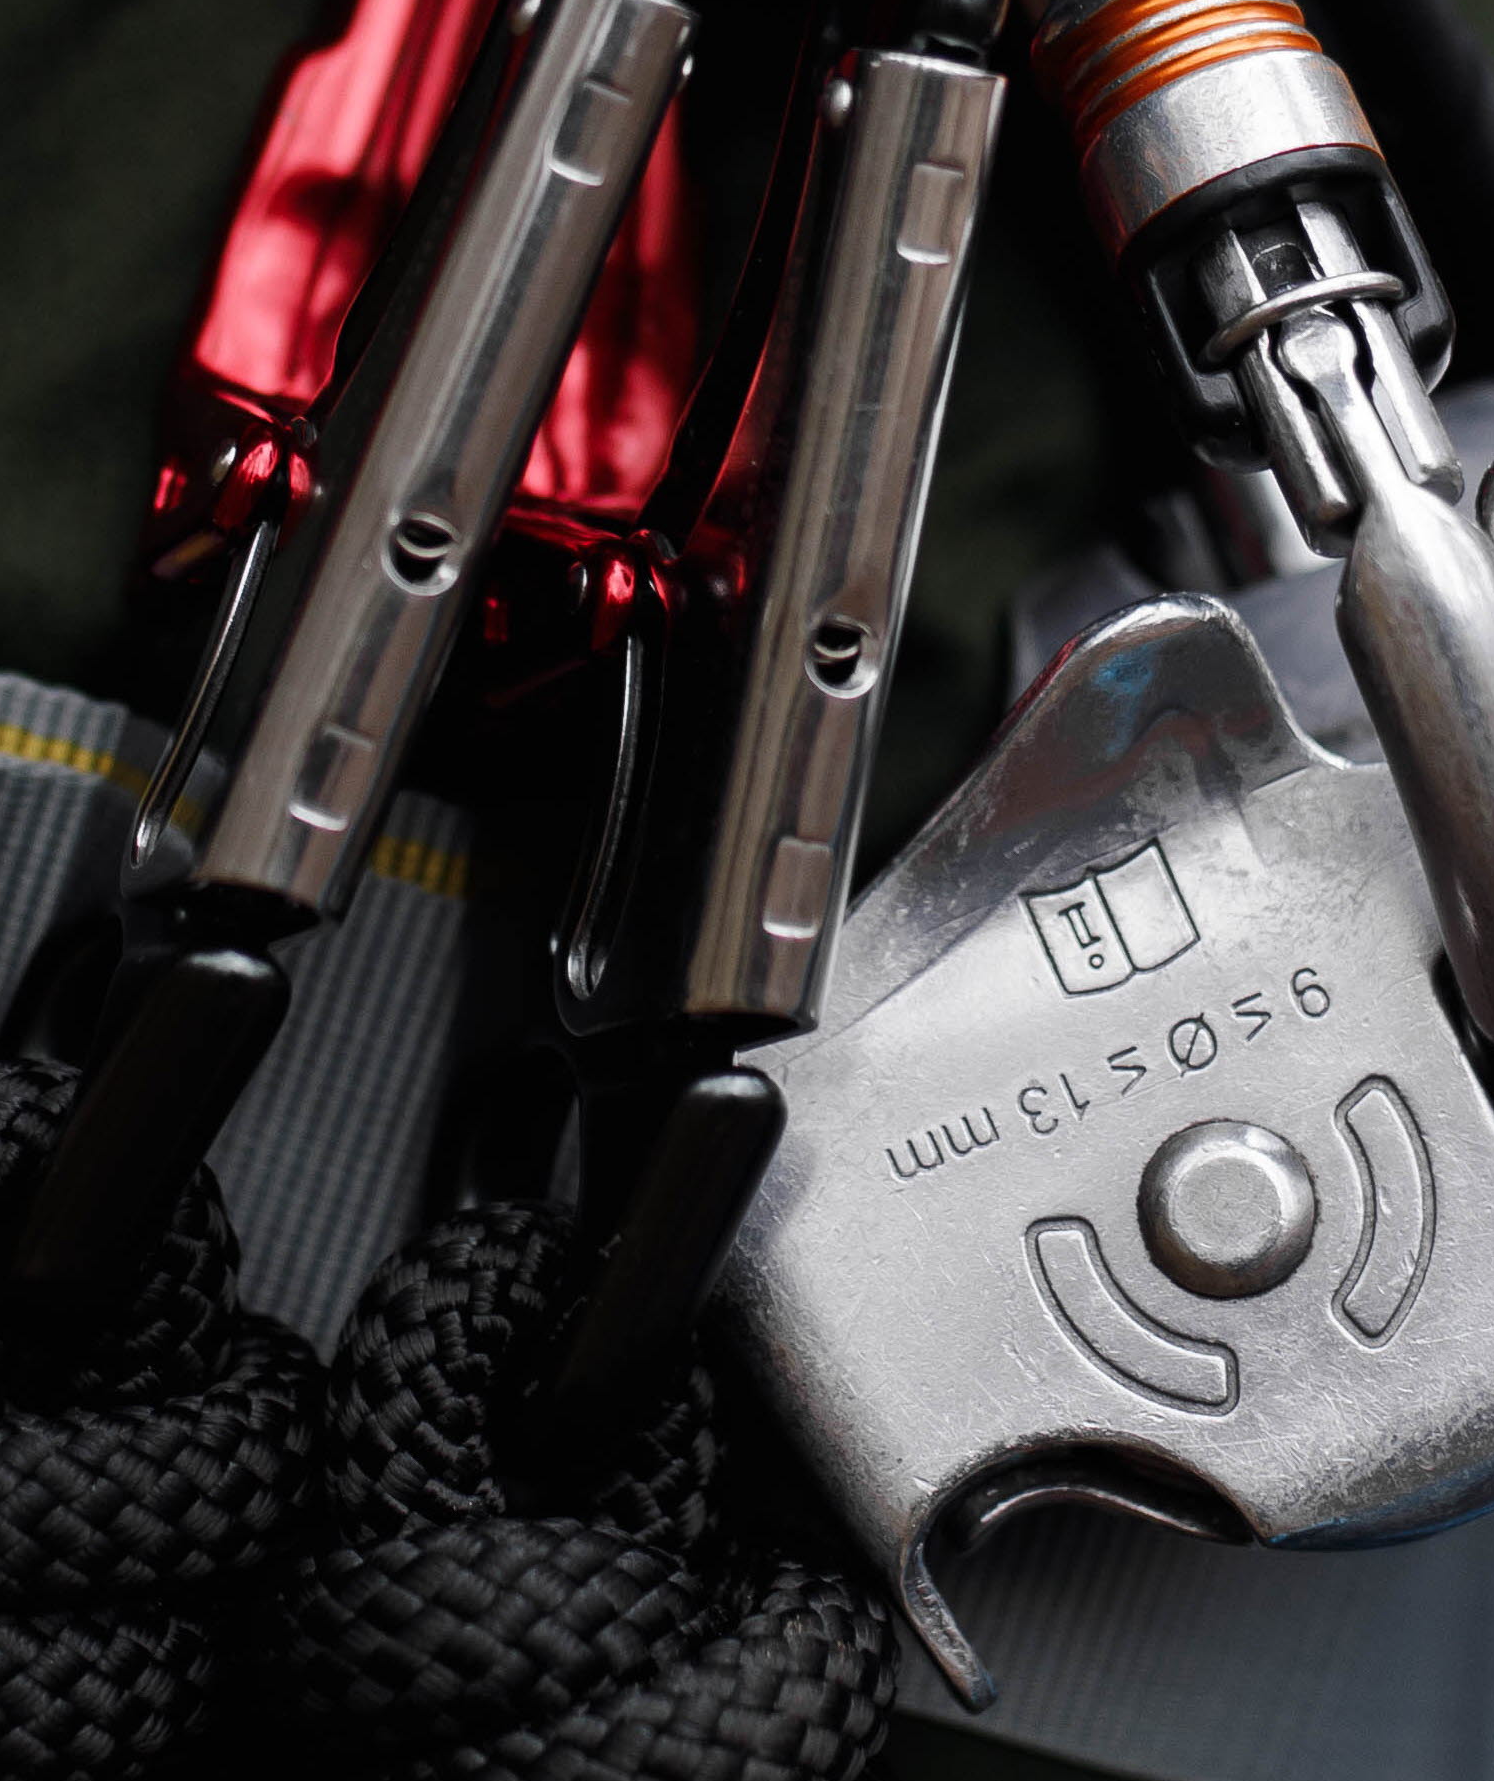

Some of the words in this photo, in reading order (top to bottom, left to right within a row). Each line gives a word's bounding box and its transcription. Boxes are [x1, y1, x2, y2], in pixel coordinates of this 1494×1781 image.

[1233, 993, 1271, 1042] ≤
[1290, 968, 1330, 1019] 9
[1107, 1048, 1146, 1096] ≤
[1165, 1014, 1217, 1078] Ø
[1016, 1072, 1091, 1135] 13
[887, 1106, 1000, 1183] mm
